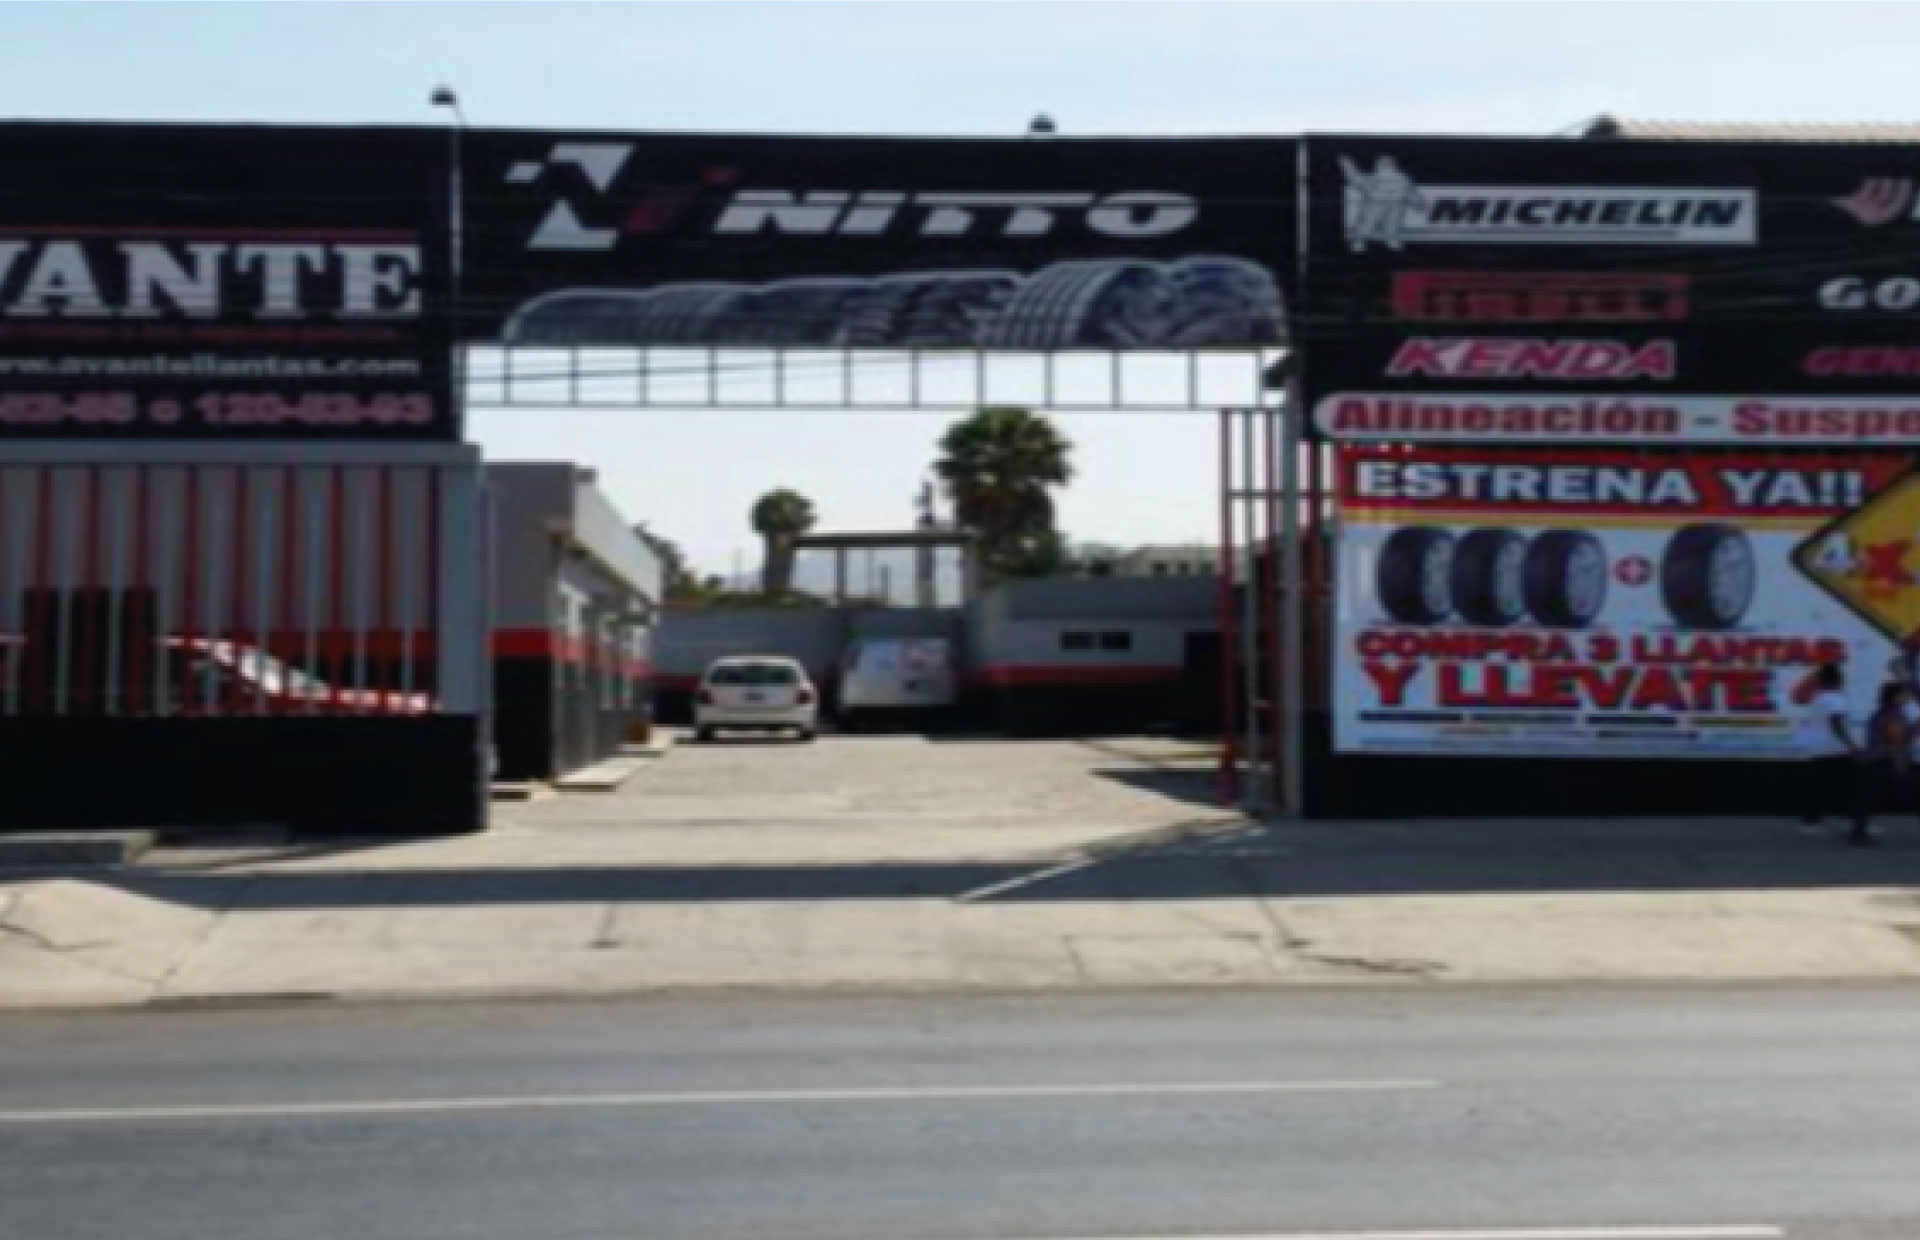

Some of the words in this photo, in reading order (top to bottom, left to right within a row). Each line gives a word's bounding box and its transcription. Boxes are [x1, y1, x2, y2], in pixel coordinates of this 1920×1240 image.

[711, 191, 1198, 235] NITTO
[1427, 200, 1742, 226] MICHELIN
[1385, 338, 1676, 379] KENDA
[1332, 401, 1680, 435] Alineación
[1356, 461, 1697, 504] ESTRENA
[1723, 470, 1863, 508] YA!!
[1356, 632, 1573, 663] COMPRA
[1584, 636, 1619, 663] 3
[1631, 637, 1846, 664] LLANTAS
[1362, 662, 1418, 706] Y
[1436, 664, 1776, 712] LLEVATE
